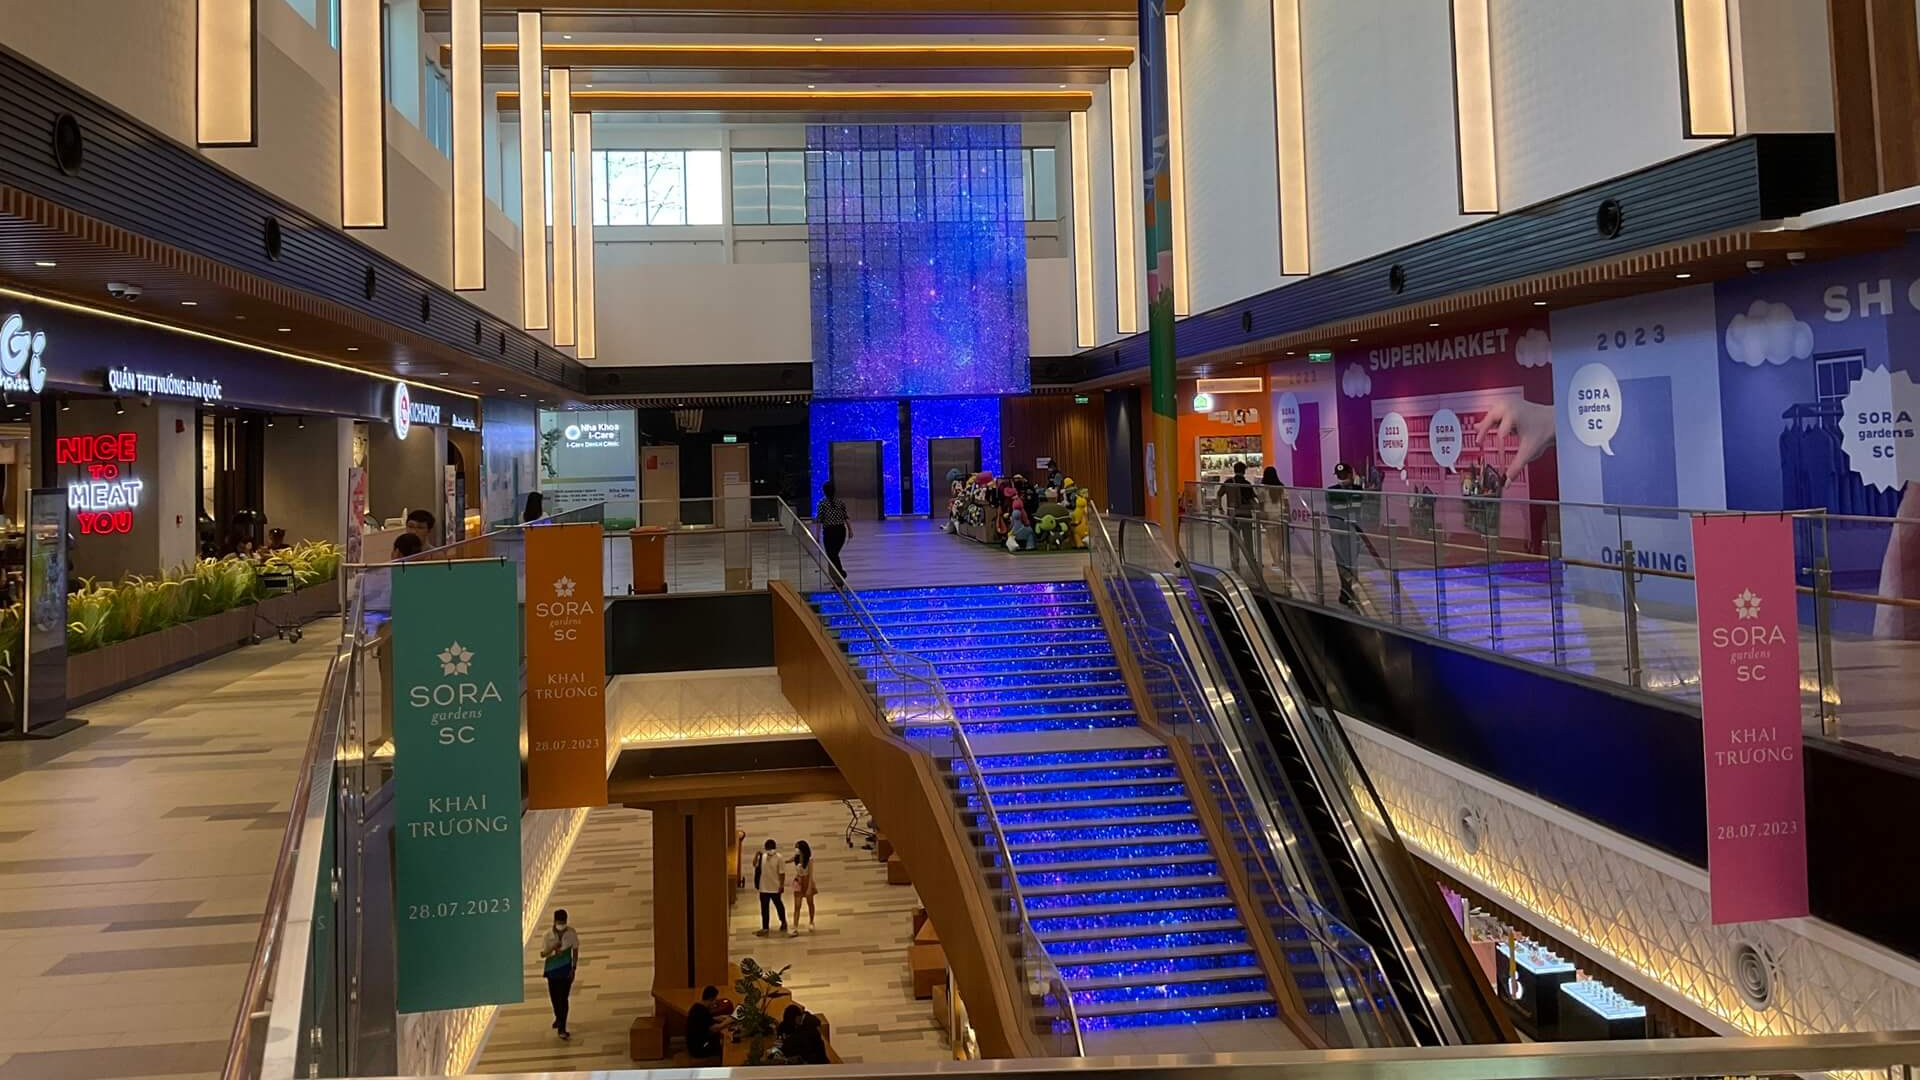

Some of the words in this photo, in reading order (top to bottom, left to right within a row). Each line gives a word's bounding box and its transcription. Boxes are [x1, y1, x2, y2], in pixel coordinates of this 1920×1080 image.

[1597, 324, 1666, 351] 2023
[1369, 328, 1510, 371] SUPERMARKET
[109, 366, 135, 392] QUÁN
[136, 373, 157, 396] THỊT
[186, 376, 202, 398] HÀN
[1578, 388, 1610, 400] SORA
[1578, 403, 1611, 415] gardens
[1858, 411, 1912, 424] SORA
[1587, 418, 1603, 430] SC
[1858, 427, 1914, 441] gardens
[56, 432, 138, 464] NICE
[1872, 446, 1895, 458] SC
[88, 464, 118, 479] TO
[68, 480, 143, 509] MEAT
[77, 511, 133, 534] YOU
[535, 600, 594, 617] SORA
[554, 628, 577, 641] SC
[1712, 624, 1786, 648] SORA
[547, 671, 585, 685] KHAI
[1736, 664, 1766, 681] SC
[409, 681, 503, 707] SORA
[430, 706, 482, 726] gardens
[438, 725, 475, 745] SC
[1731, 727, 1776, 744] KHAI
[535, 738, 600, 752] 28.07.2023
[428, 794, 487, 813] KHAI
[407, 815, 508, 838] TRƯƠNG
[1718, 820, 1797, 840] 28.07.2023
[408, 897, 511, 920] 28.07.2023
